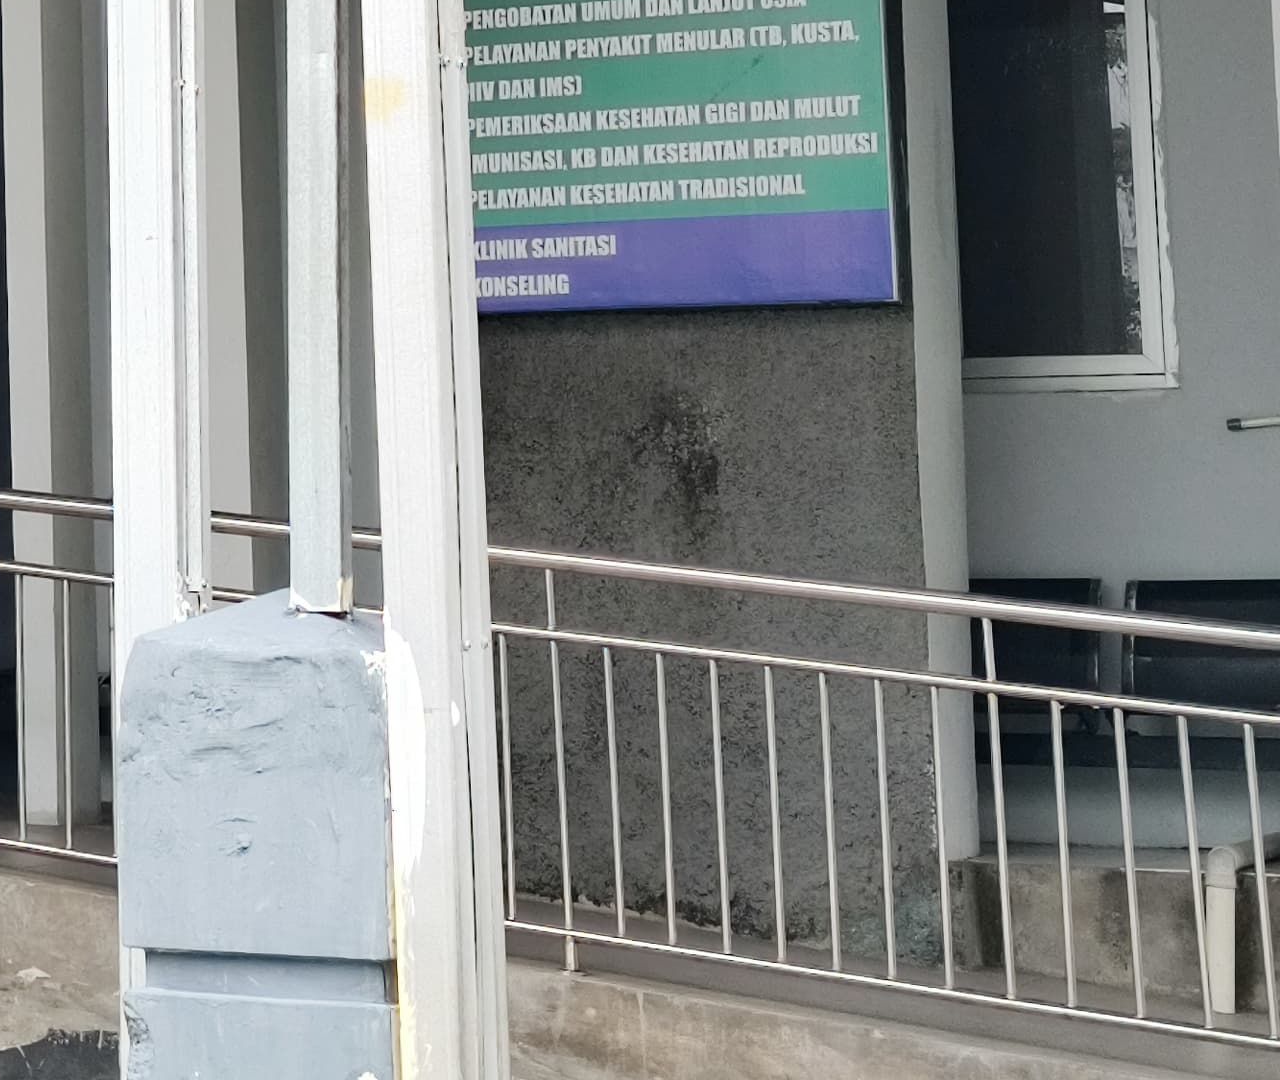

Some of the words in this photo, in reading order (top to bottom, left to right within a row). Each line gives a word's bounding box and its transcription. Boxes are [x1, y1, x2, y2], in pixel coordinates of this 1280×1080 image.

[464, 2, 577, 30] PENGOBATAN
[466, 38, 561, 68] PELAYANAN
[564, 33, 652, 61] PENYAKIT
[656, 28, 746, 56] MENULAR
[790, 18, 860, 46] KUSTA,
[498, 77, 535, 100] DAN
[539, 74, 583, 98] IMS)
[468, 111, 592, 138] PEMERIKSAAN
[596, 106, 701, 134] KESEHATAN
[704, 102, 746, 126] GIGI
[750, 98, 790, 122] DAN
[793, 94, 861, 120] MULUT
[472, 150, 568, 175] MUNISASI,
[571, 148, 597, 169] KB
[600, 143, 640, 168] DAN
[642, 138, 749, 166] KESEHATAN
[753, 132, 879, 159] REPRODUKSI
[570, 179, 674, 206] KESEHATAN
[678, 173, 806, 200] TRADISIONAL
[532, 234, 617, 258] SANITASI
